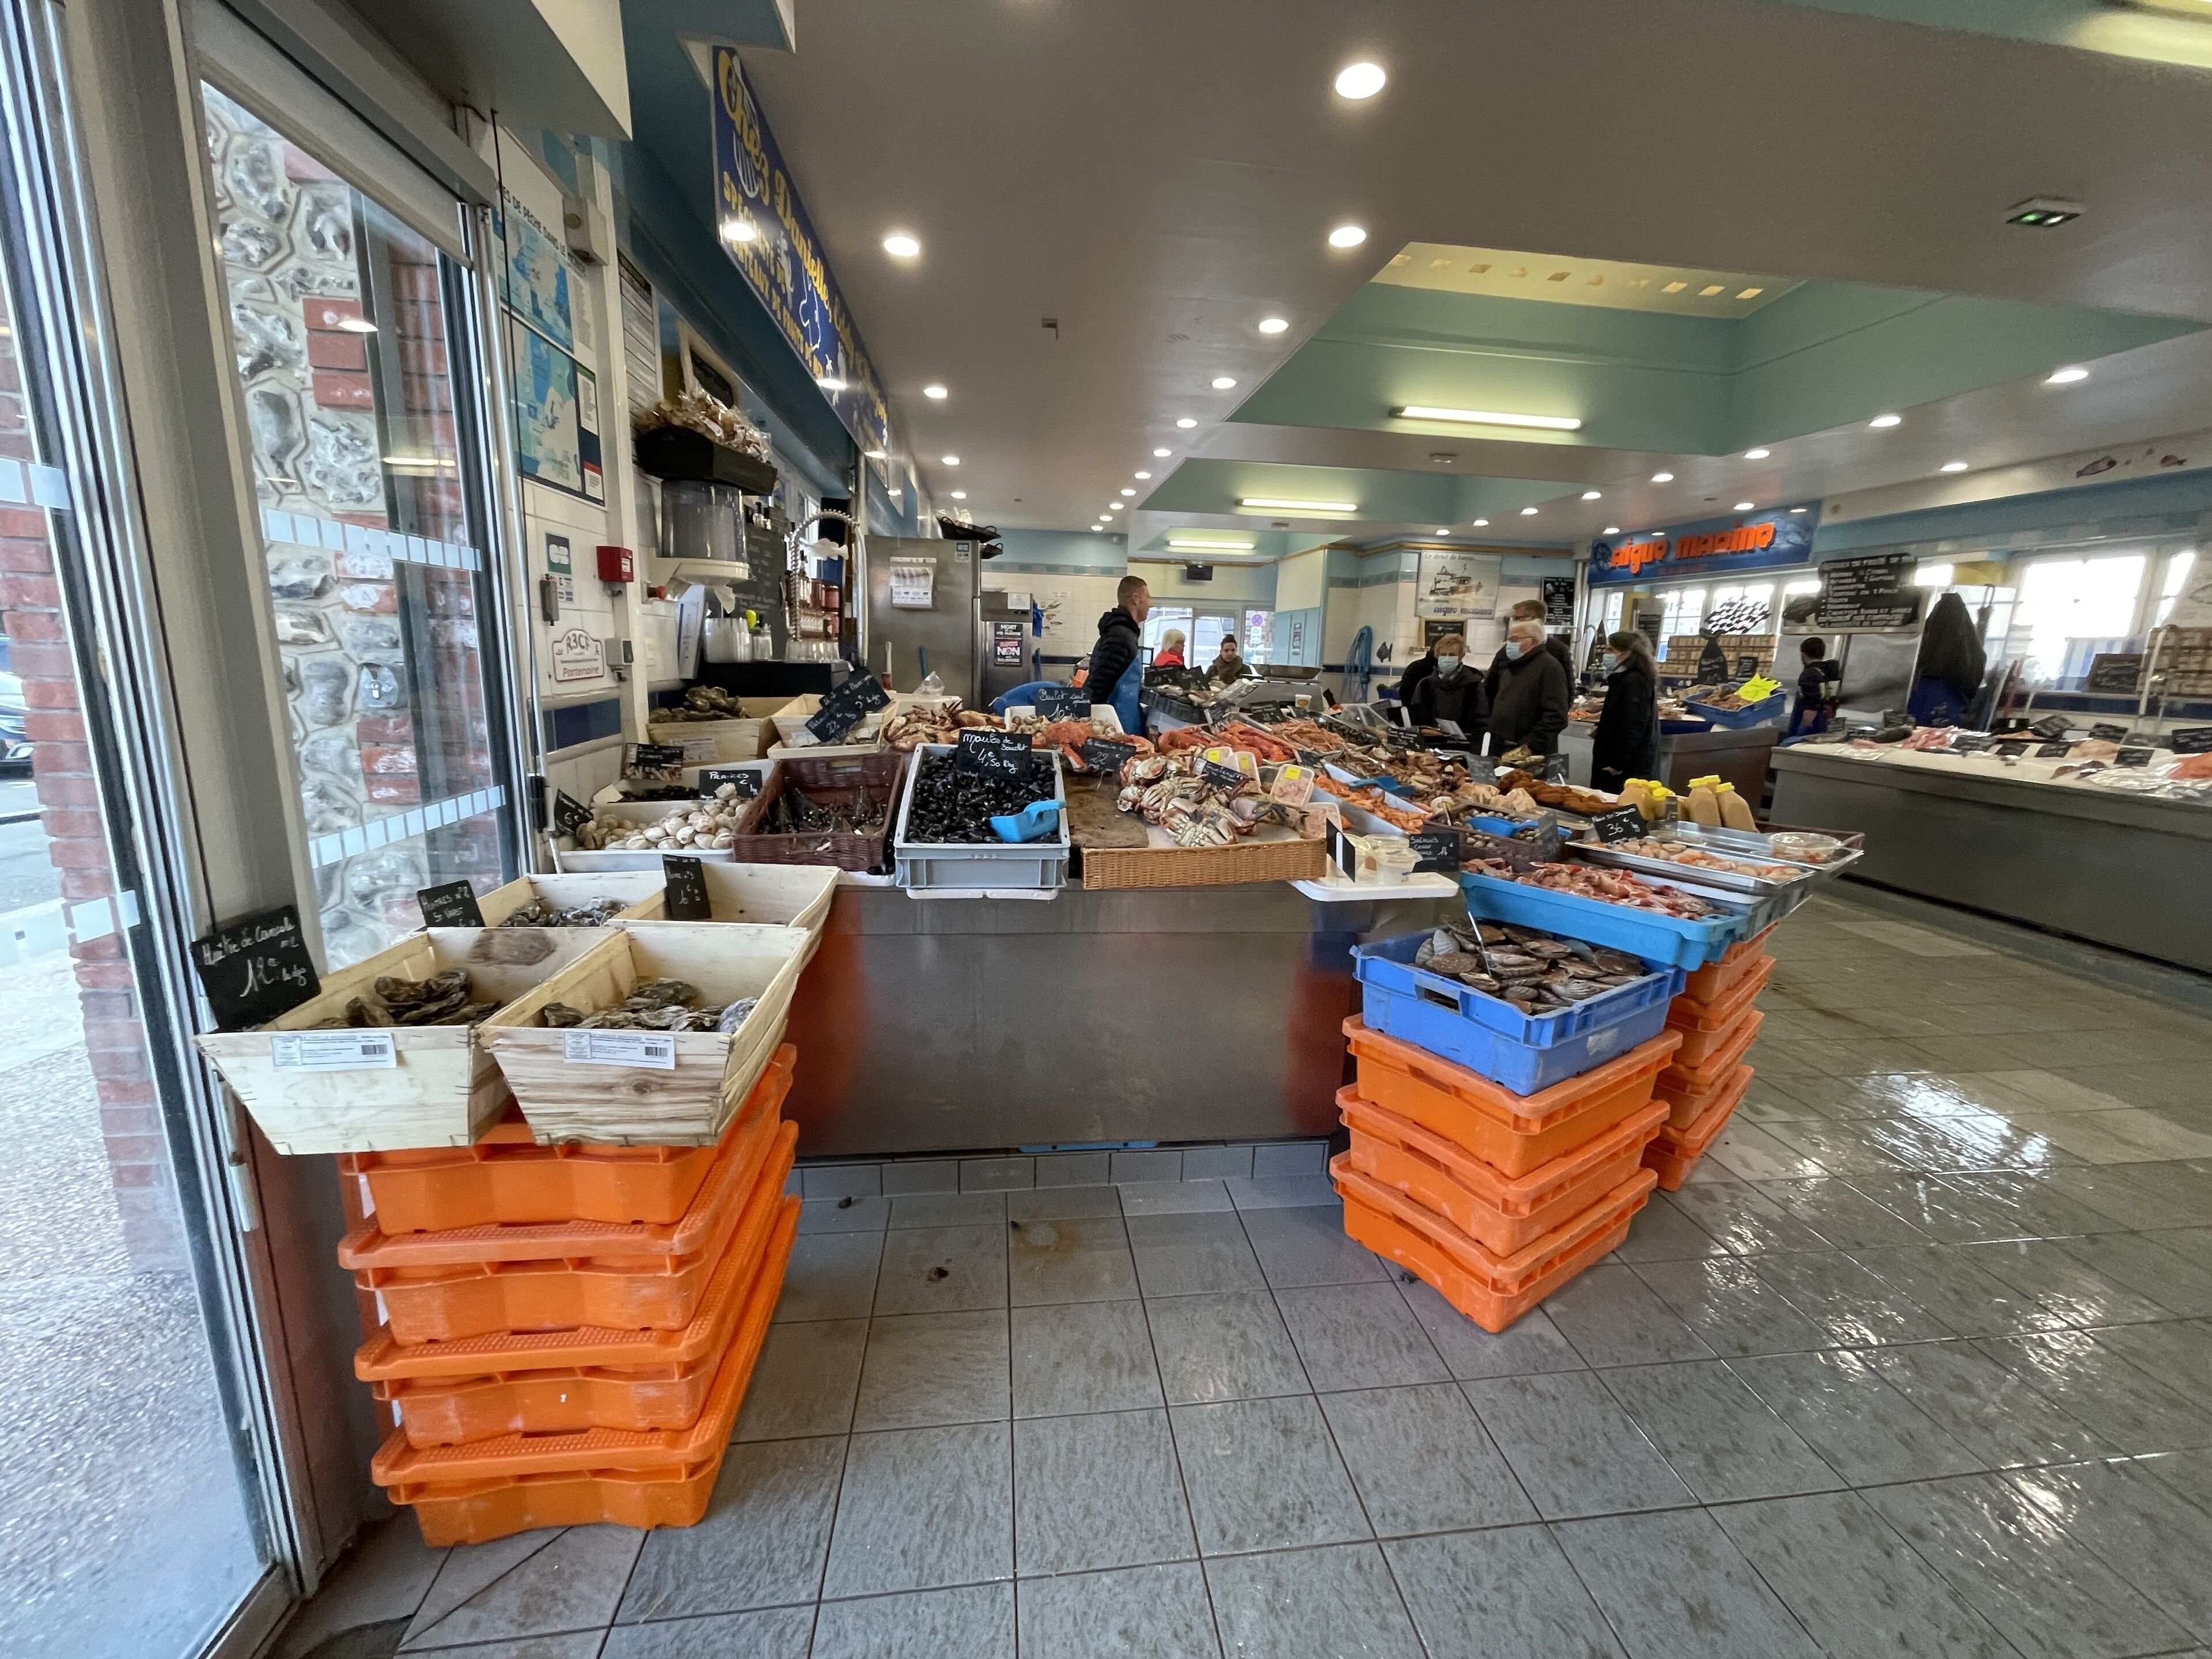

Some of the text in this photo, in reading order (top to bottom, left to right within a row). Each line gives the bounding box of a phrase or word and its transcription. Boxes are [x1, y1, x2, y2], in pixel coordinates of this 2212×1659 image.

[718, 50, 769, 206] Chez
[997, 646, 1020, 656] NON
[563, 667, 600, 677] Partenaire
[963, 733, 1001, 753] Moules
